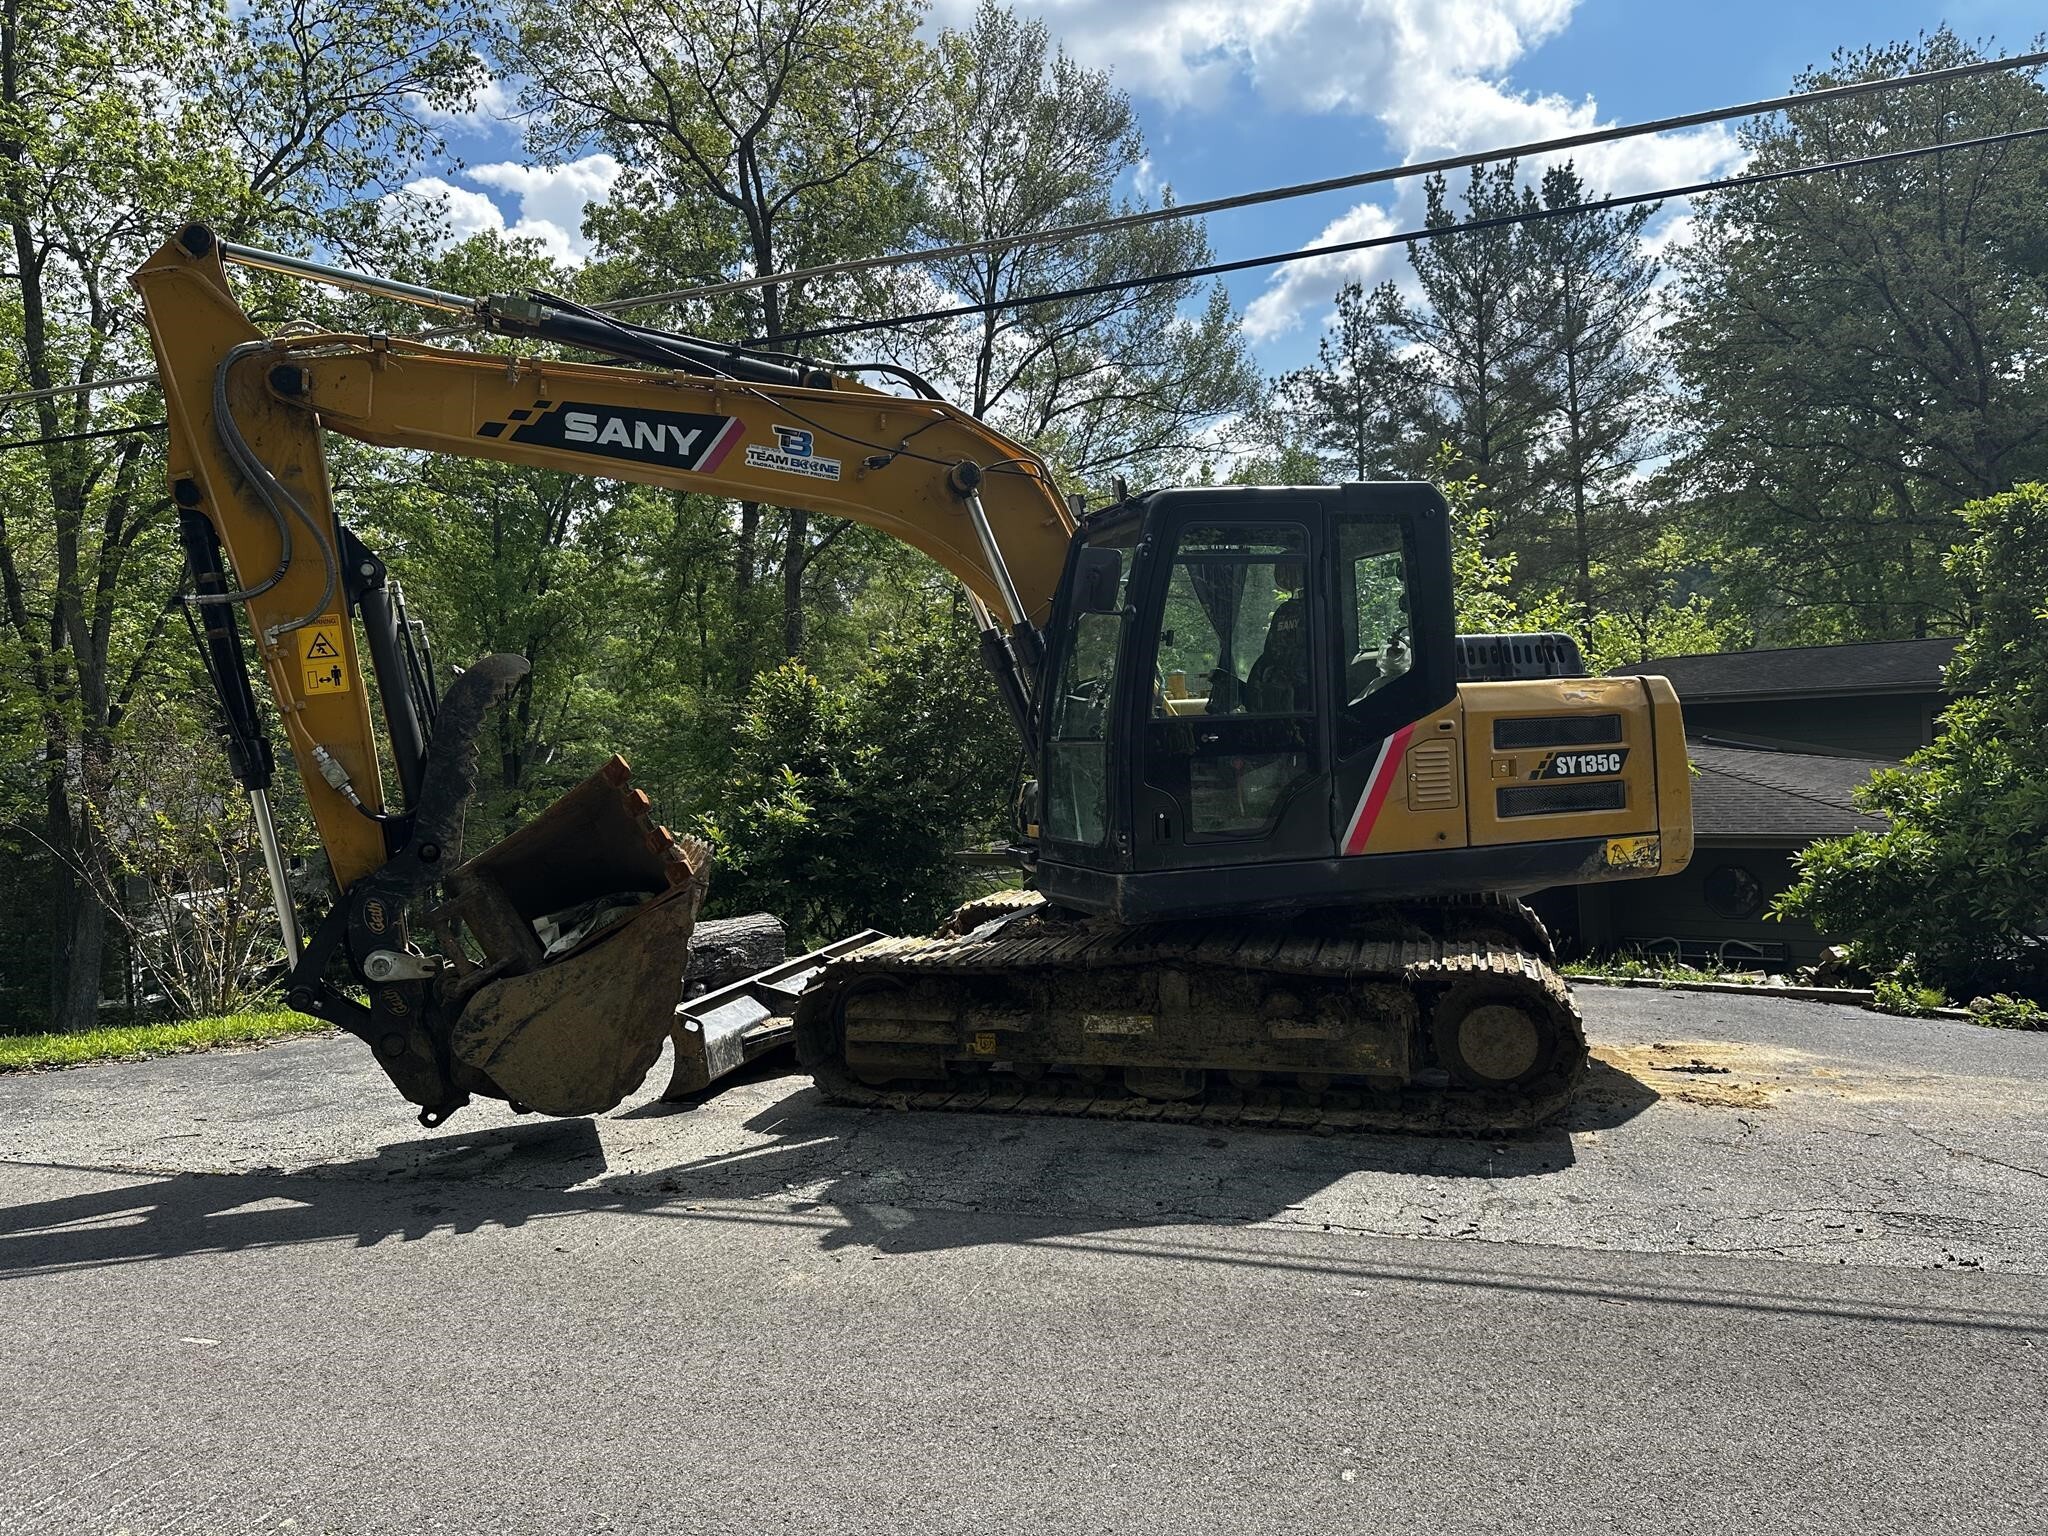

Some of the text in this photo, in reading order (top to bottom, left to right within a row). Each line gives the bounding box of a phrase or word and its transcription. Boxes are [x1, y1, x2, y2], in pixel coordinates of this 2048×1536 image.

[564, 411, 703, 456] SANY
[748, 449, 840, 475] TEAM BOONE
[752, 461, 775, 469] GLOBAL
[776, 465, 809, 475] EQUIPMENT
[810, 471, 839, 480] PROVIDER
[1277, 618, 1299, 632] SANY
[1556, 753, 1621, 775] SY135C
